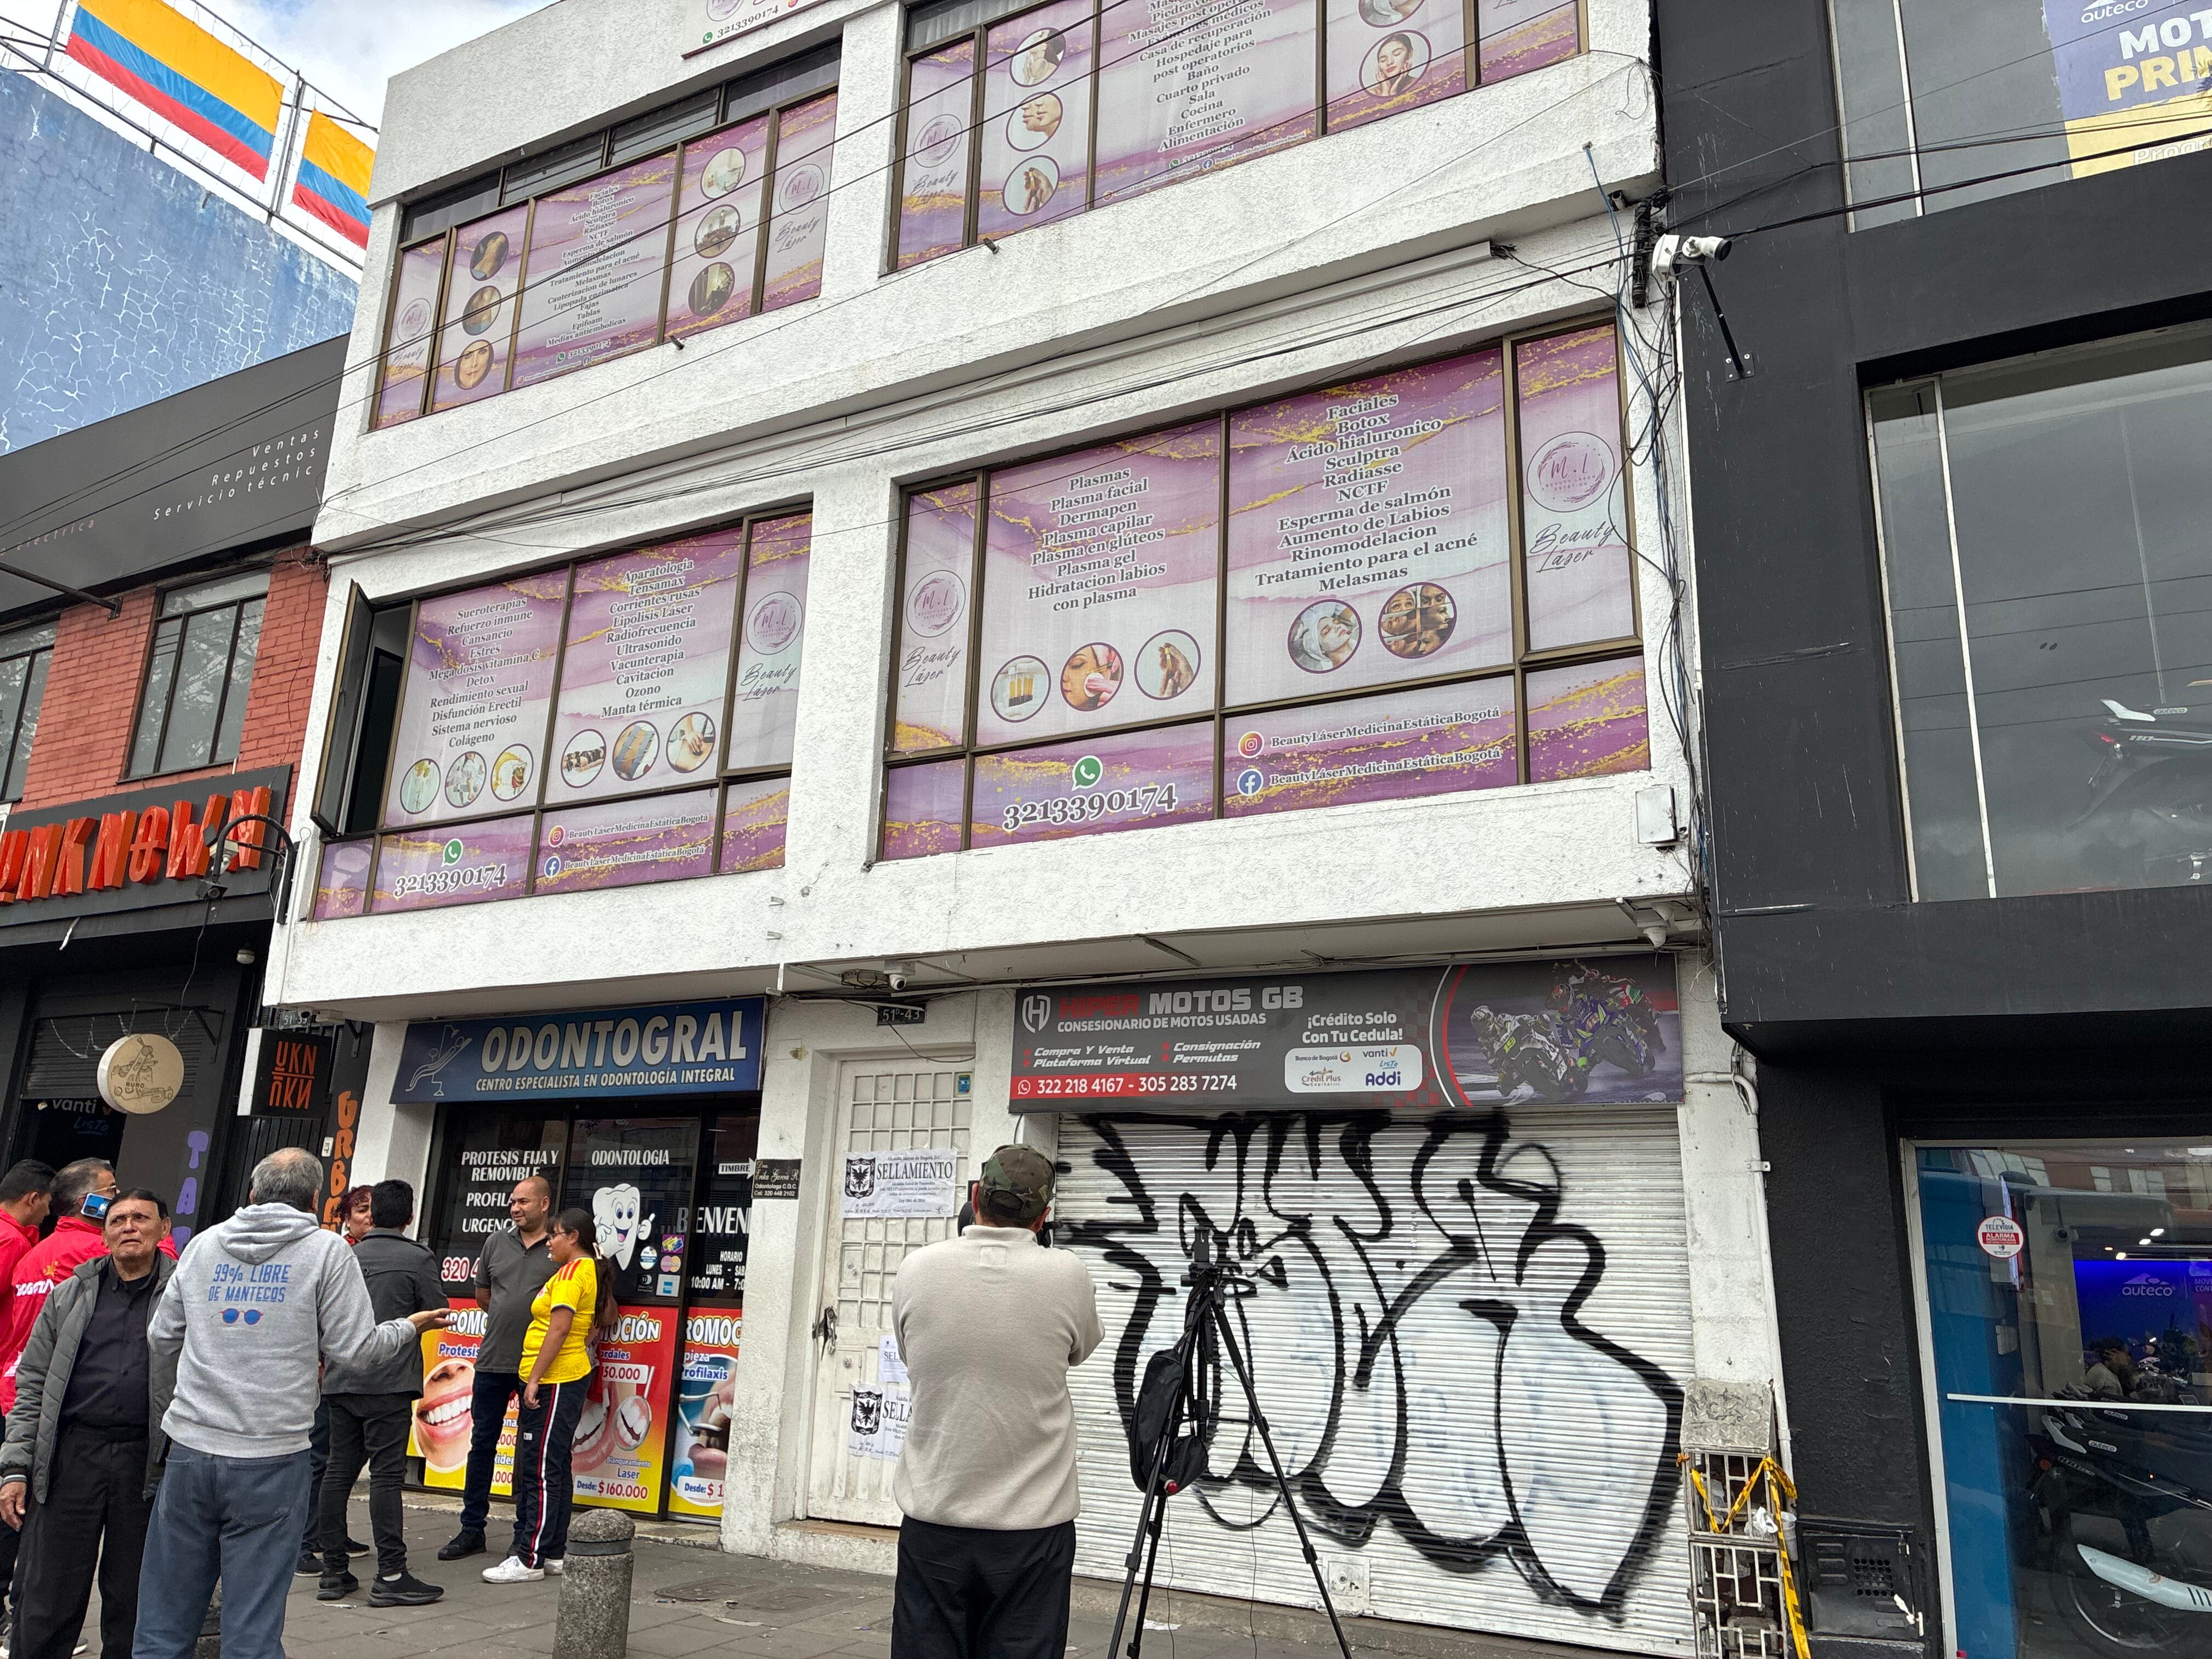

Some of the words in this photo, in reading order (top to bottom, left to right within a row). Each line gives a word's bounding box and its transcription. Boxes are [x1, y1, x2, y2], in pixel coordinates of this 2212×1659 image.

[2081, 0, 2148, 22] auteco
[1139, 46, 1167, 61] Casa
[1170, 40, 1185, 51] de
[1187, 10, 1271, 45] recuperación
[1169, 108, 1236, 136] Enfermero
[1159, 117, 1244, 151] Alimentación
[572, 317, 603, 330] Epifoam
[577, 309, 601, 320] Tablas
[1327, 394, 1398, 419] Faciales
[1337, 414, 1389, 435] Botox
[252, 428, 319, 457] Ventas
[1286, 443, 1334, 462] Ácido
[1338, 420, 1442, 452] hialuronico
[211, 447, 316, 487] Repuestos
[1325, 445, 1400, 471] Sculptra
[1069, 469, 1130, 491] Plasmas
[1324, 462, 1402, 487] Radiasse
[1051, 492, 1103, 512] Plasma
[1107, 479, 1148, 499] facial
[1338, 480, 1388, 501] NCTF
[153, 487, 235, 520] Servicio
[1059, 500, 1137, 526] Dermapen
[1278, 506, 1354, 532] Esperma
[1359, 499, 1380, 514] de
[1384, 487, 1451, 509] salmón
[1043, 527, 1096, 547] Plasma
[1100, 514, 1153, 537] capilar
[1279, 522, 1358, 548] Aumento
[1363, 516, 1385, 530] de
[1389, 504, 1450, 526] Labios
[1032, 545, 1084, 566] Plasma
[1087, 541, 1106, 554] en
[1109, 529, 1164, 551] glúteos
[1291, 526, 1437, 562] Rinomodelacion
[1057, 557, 1110, 577] Plasma
[1114, 550, 1136, 568] gel
[1255, 556, 1362, 586] Tratamiento
[1367, 547, 1409, 568] para
[1413, 542, 1430, 555] el
[1434, 533, 1478, 554] acné
[623, 558, 693, 585] Aparatologia
[1028, 573, 1116, 599] Hidratacion
[1120, 563, 1166, 582] labios
[1319, 566, 1408, 591] Melasmas
[629, 576, 685, 595] Tensamax
[456, 597, 527, 620] Sueroterapias
[610, 595, 667, 615] Corrientes
[669, 588, 700, 602] rusas
[1053, 599, 1079, 611] con
[1083, 587, 1137, 609] plasma
[447, 620, 491, 635] Refuerzo
[494, 611, 533, 625] inmune
[612, 611, 659, 628] Lipolisis
[662, 603, 693, 618] Láser
[462, 628, 512, 647] Cansancio
[606, 618, 696, 644] Radiofrecuencia
[469, 645, 500, 658] Estrés
[617, 635, 682, 656] Ultrasonido
[610, 650, 684, 672] Vacunterapia
[466, 674, 496, 687] Detox
[616, 667, 674, 685] Cavitacion
[430, 688, 494, 708] Rendimiento
[495, 680, 528, 696] sexual
[625, 685, 661, 698] Ozono
[432, 701, 485, 721] Disfunción
[488, 696, 522, 713] Erectil
[601, 704, 636, 718] Manta
[639, 696, 682, 711] térmica
[431, 721, 471, 737] Sistema
[473, 714, 517, 732] nervioso
[448, 732, 495, 748] Colágeno
[1004, 784, 1177, 831] 3213390174
[395, 865, 506, 898] 3213390174
[1059, 995, 1140, 1019] HIPER
[1149, 988, 1252, 1015] MOTOS
[1262, 985, 1303, 1010] GB
[1057, 1017, 1152, 1032] CONSESIONARIO
[1153, 1017, 1169, 1029] DE
[1170, 1015, 1214, 1028] MOTOS
[1215, 1013, 1266, 1026] USADAS
[1307, 1013, 1363, 1029] ¡Crédito
[1365, 1011, 1397, 1024] Solo
[481, 1010, 747, 1073] ODONTOGRAL
[1173, 1039, 1261, 1053] Consignación
[1302, 1031, 1328, 1043] Con
[1330, 1030, 1348, 1042] Tu
[1350, 1028, 1403, 1042] Cedula!
[1034, 1046, 1082, 1057] Compra
[1085, 1046, 1094, 1054] Y
[1098, 1044, 1134, 1054] Venta
[1172, 1053, 1239, 1064] Permutas
[1033, 1057, 1103, 1069] Plataforma
[1107, 1055, 1151, 1066] Virtual
[475, 1076, 512, 1092] CENTRO
[515, 1073, 580, 1090] ESPECIALISTA
[583, 1073, 598, 1088] EN
[601, 1067, 677, 1087] ODONTOLOGÍA
[680, 1067, 736, 1084] INTEGRAL
[1037, 1079, 1063, 1094] 322
[1065, 1079, 1088, 1093] 218
[1091, 1077, 1124, 1093] 4167
[1138, 1076, 1166, 1091] 305
[1170, 1076, 1198, 1091] 283
[1201, 1075, 1237, 1090] 7274
[1365, 1071, 1401, 1086] Addi
[461, 1151, 519, 1165] PROTESIS
[523, 1150, 548, 1165] FIJA
[550, 1150, 559, 1165] Y
[591, 1149, 669, 1166] ODONTOLOGIA
[877, 1162, 952, 1180] SELLAMIENTO
[720, 1251, 743, 1262] HORARIO
[212, 1263, 244, 1282] 99%
[249, 1263, 292, 1283] LIBRE
[706, 1264, 723, 1275] LUNES
[691, 1276, 710, 1289] 10:00
[712, 1278, 724, 1290] AM
[2122, 1285, 2173, 1296] auteco
[208, 1286, 219, 1301] DE
[224, 1285, 286, 1304] MANTECOS
[2090, 1441, 2115, 1451] auteco
[607, 1457, 651, 1468] Blanqueamiento
[617, 1468, 640, 1479] Laser
